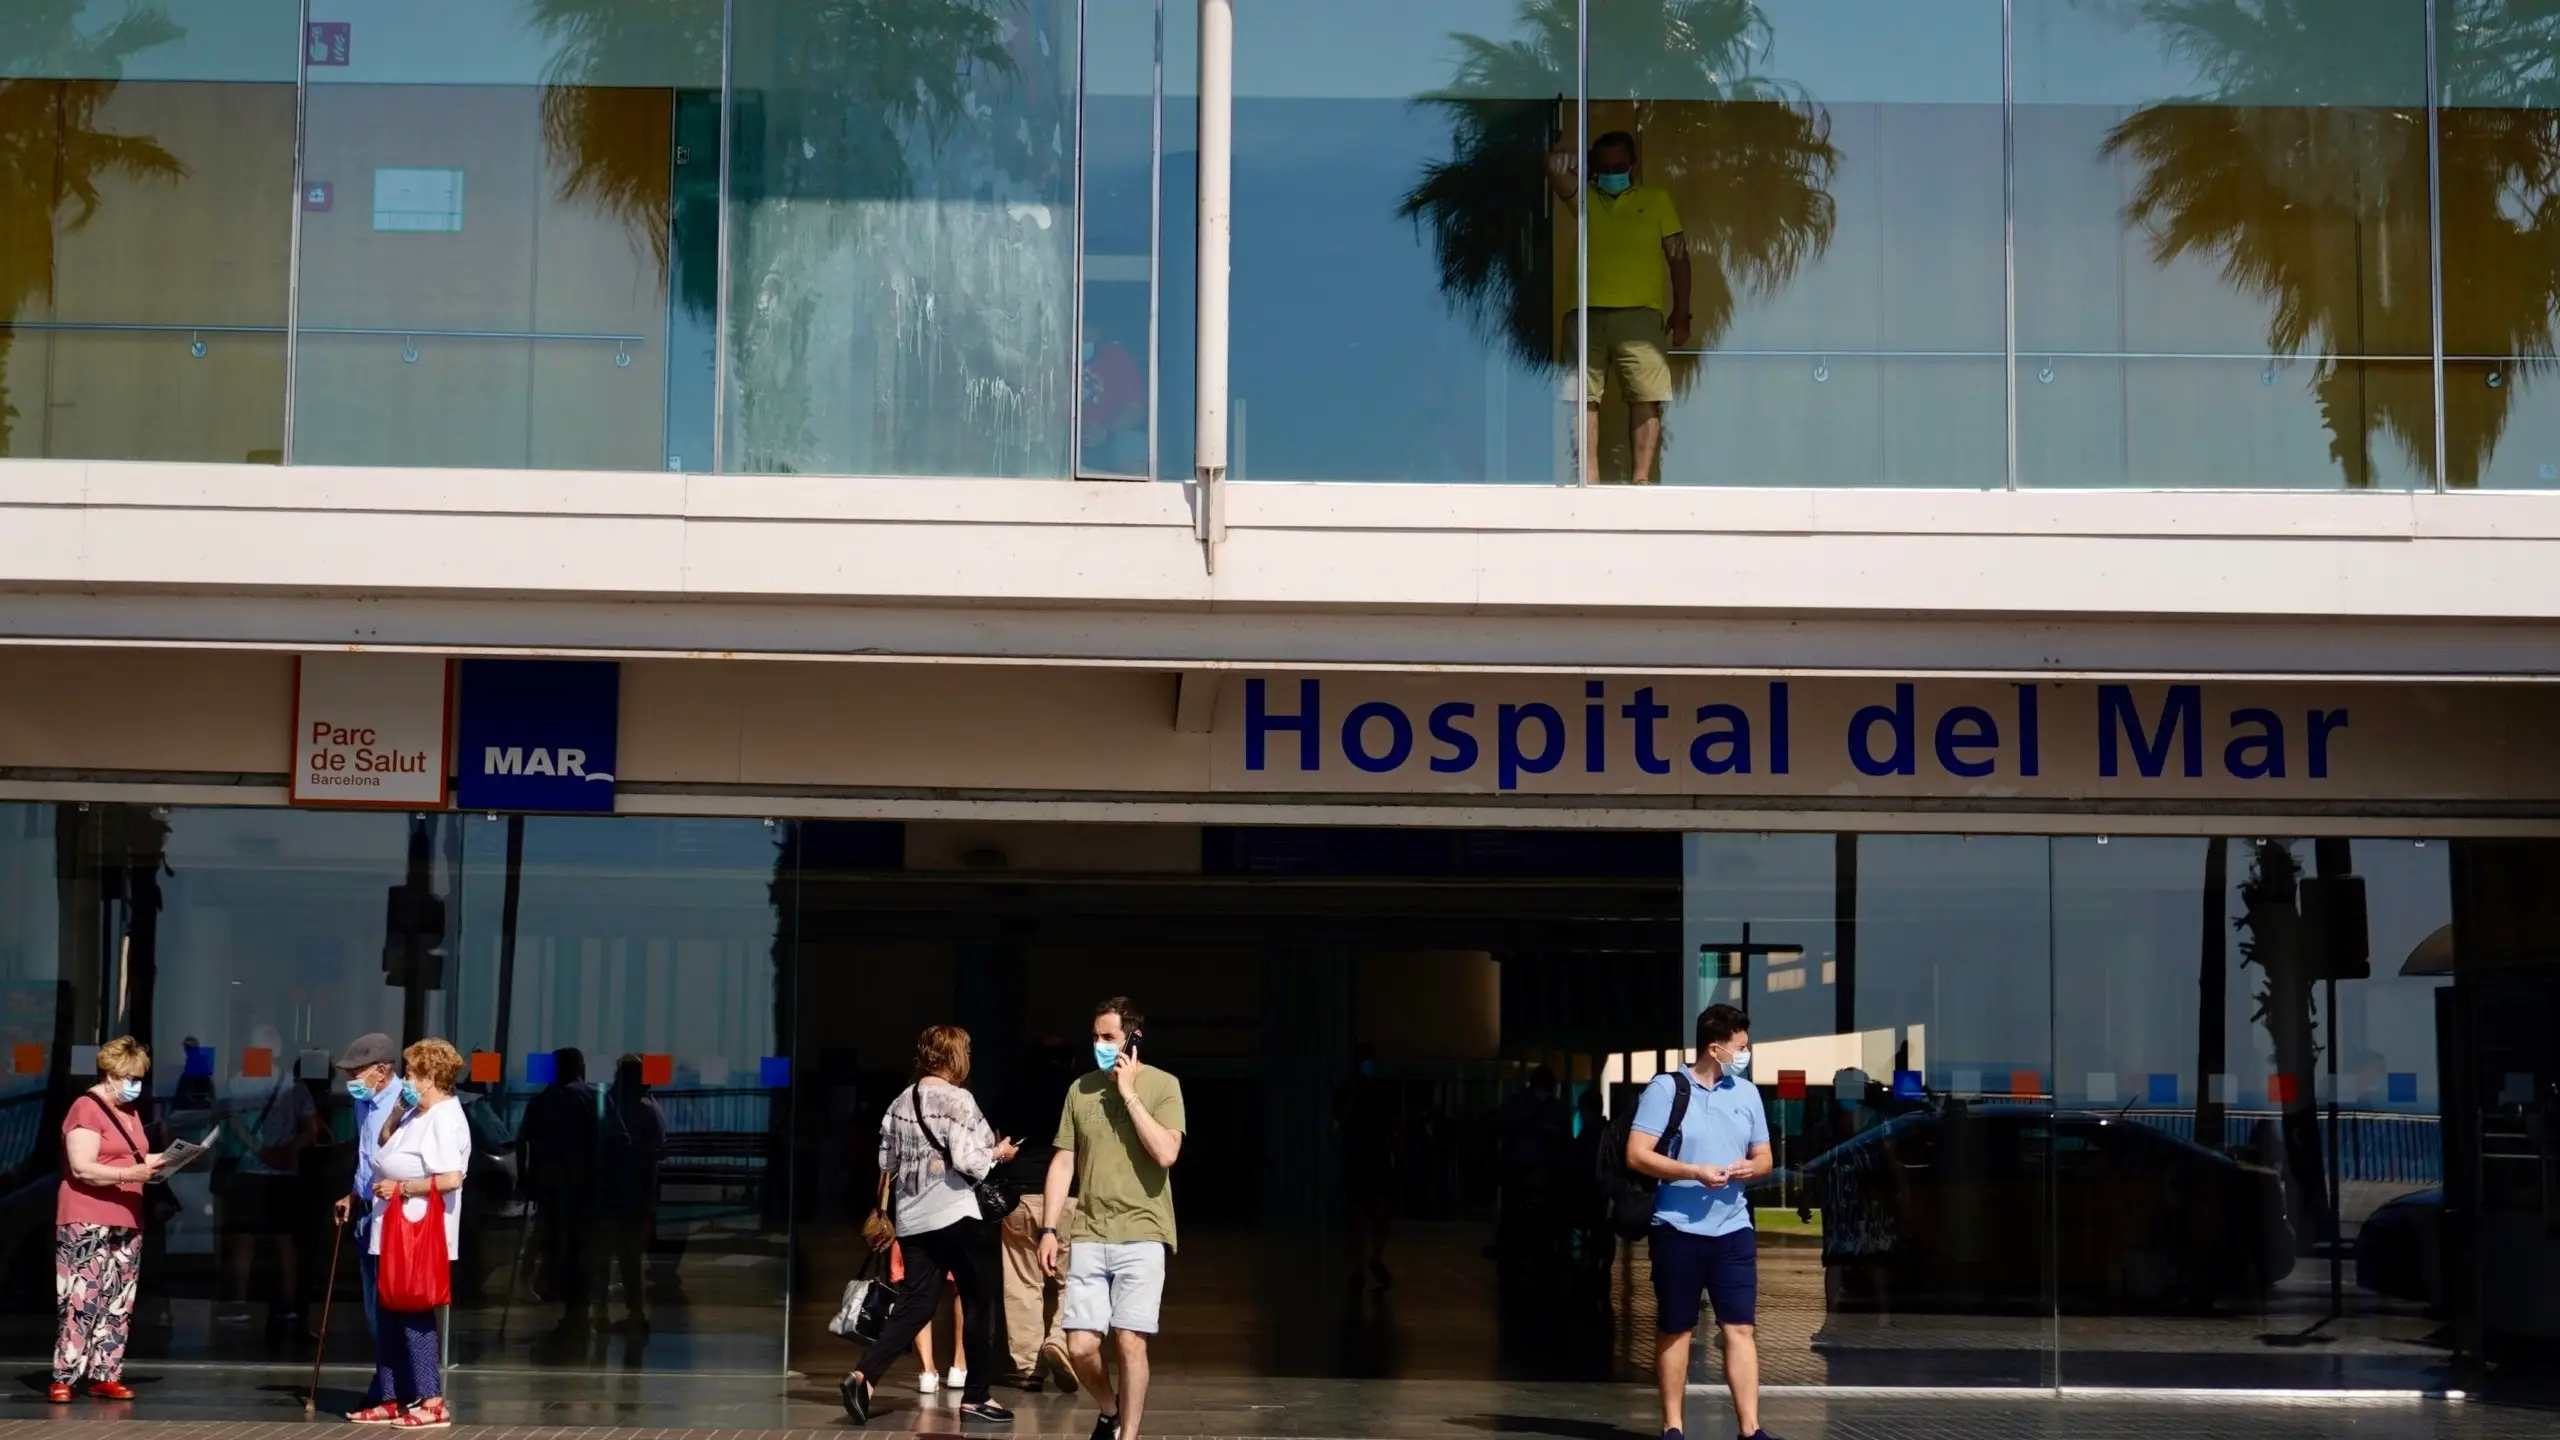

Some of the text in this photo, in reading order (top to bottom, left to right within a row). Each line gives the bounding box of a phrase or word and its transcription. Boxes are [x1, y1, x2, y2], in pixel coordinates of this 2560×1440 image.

[312, 721, 377, 746] Parc
[1245, 678, 2349, 790] Hospital del Mar
[310, 747, 427, 773] de Salut
[484, 746, 587, 777] MAR
[311, 773, 380, 786] Barcelona
